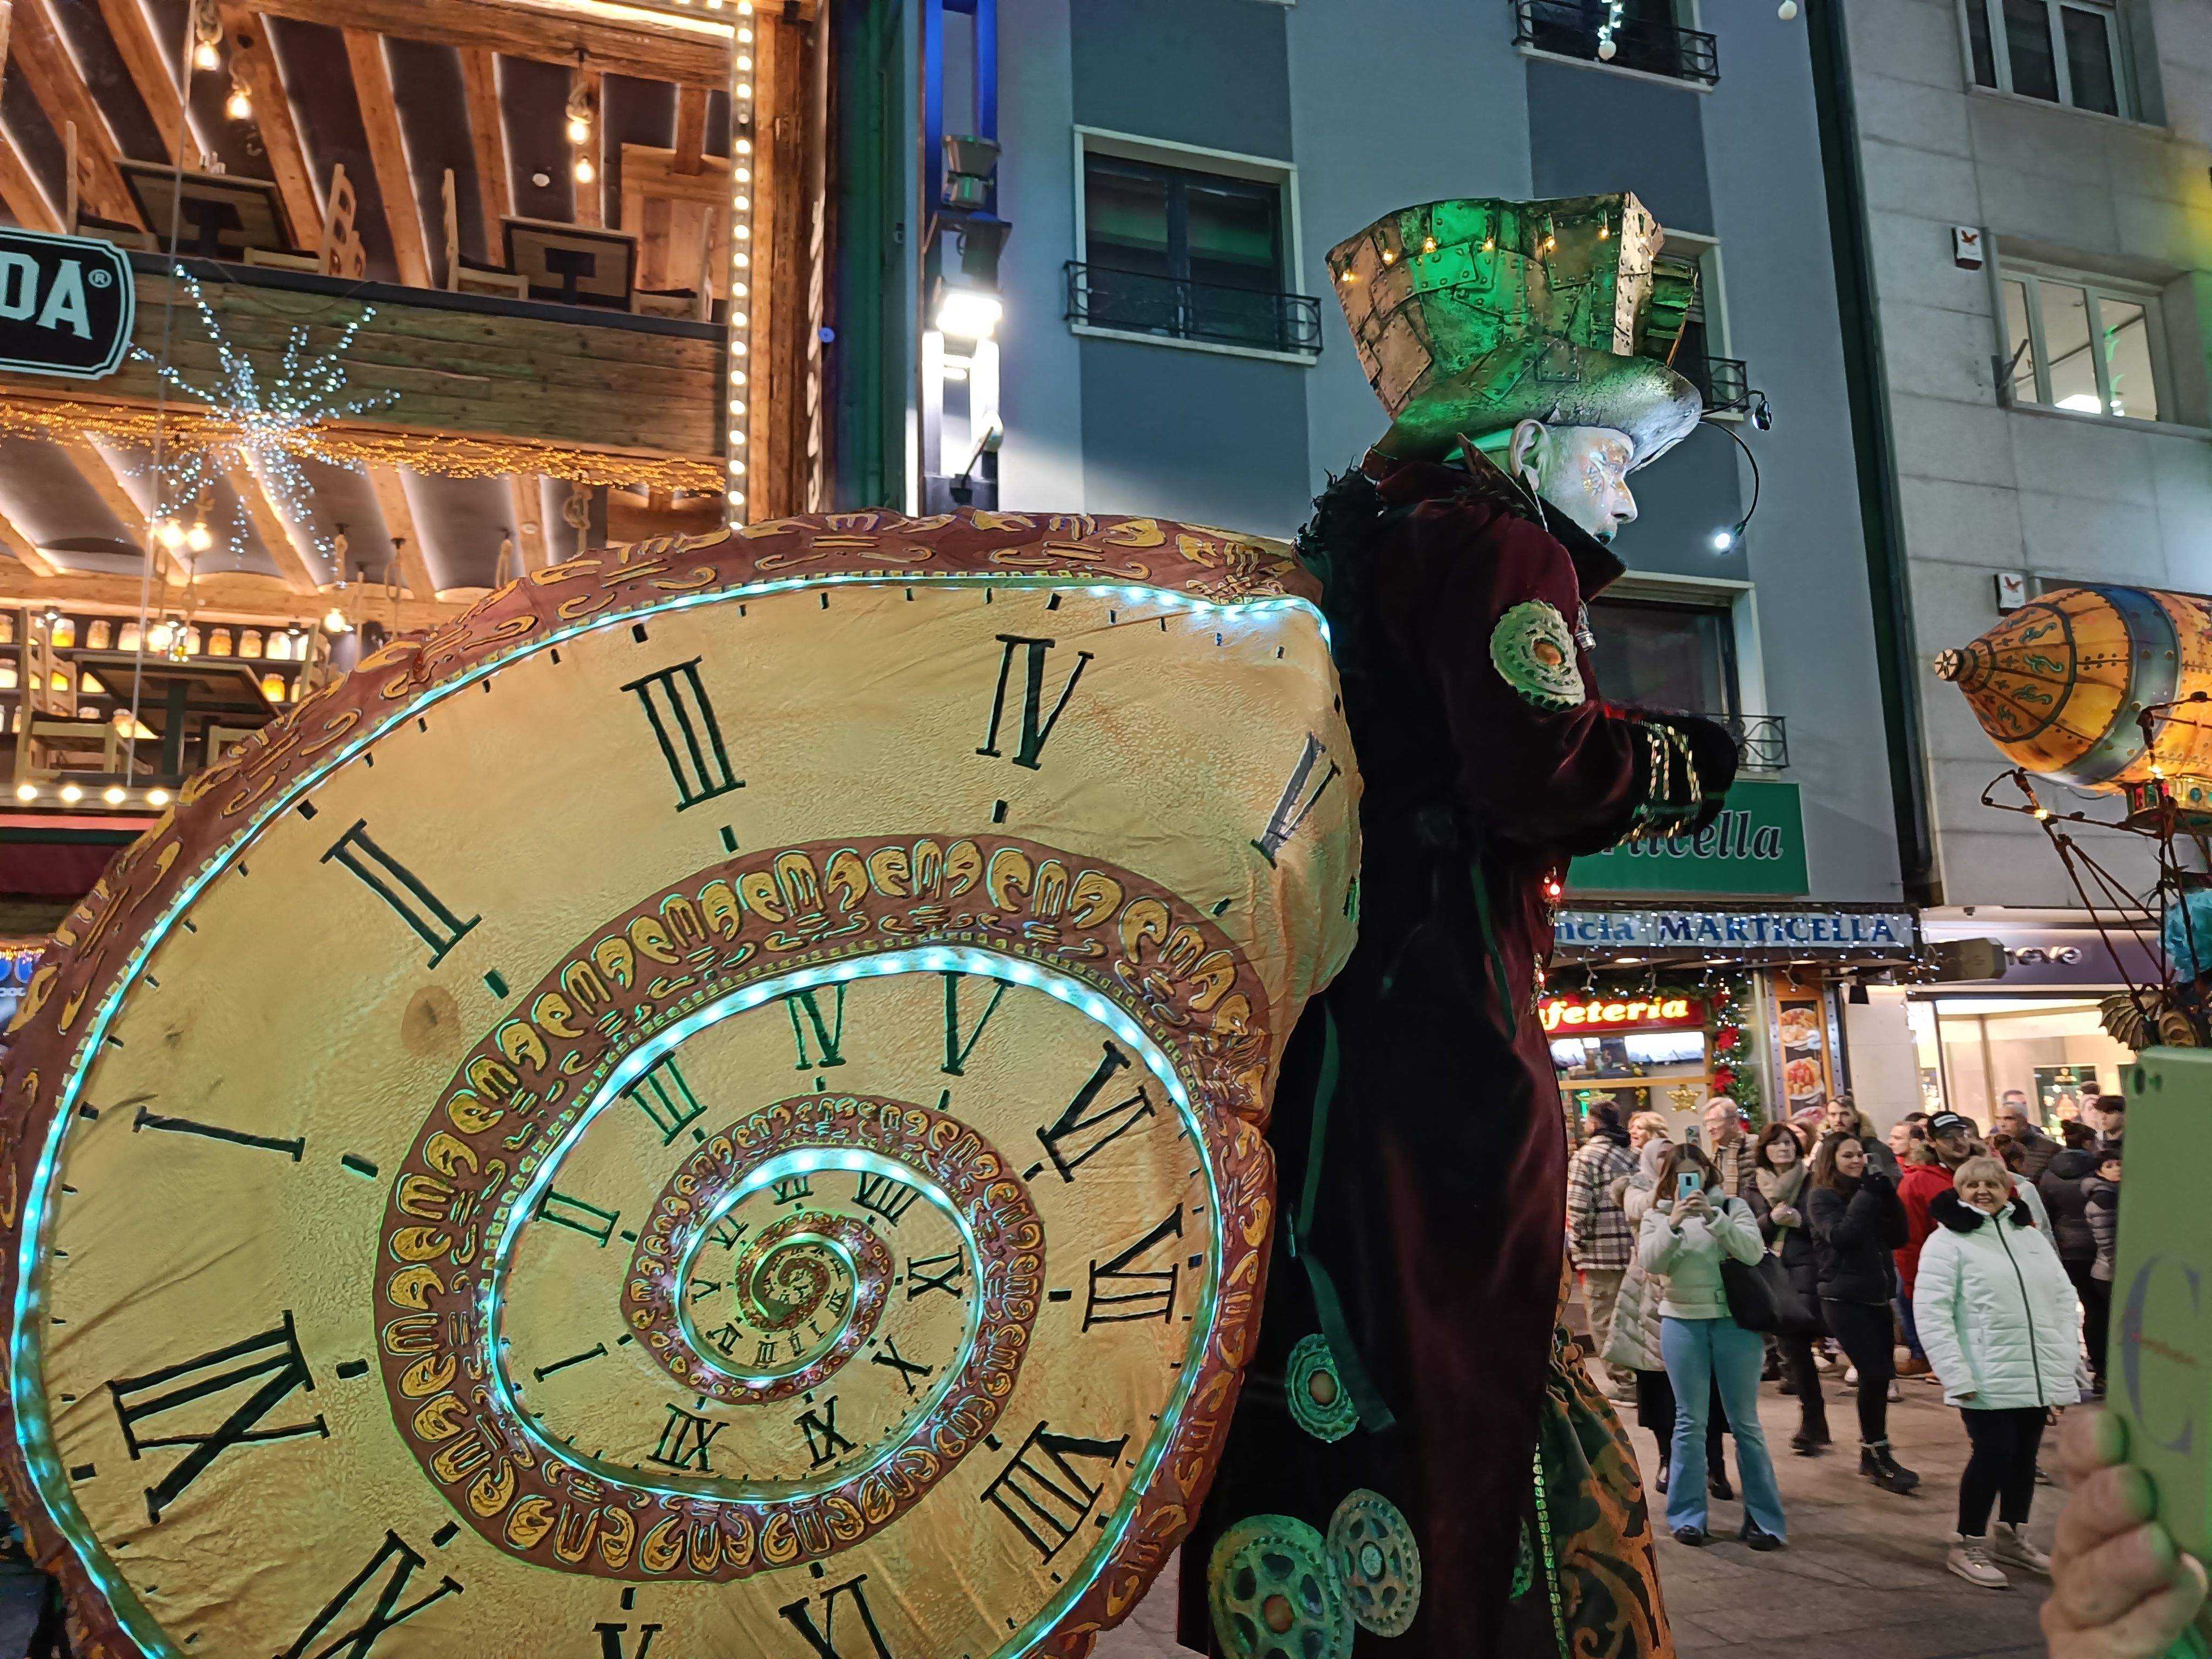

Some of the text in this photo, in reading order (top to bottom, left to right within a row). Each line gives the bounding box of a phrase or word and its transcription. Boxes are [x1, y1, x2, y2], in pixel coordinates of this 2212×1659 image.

[620, 656, 745, 812] III
[976, 633, 1094, 770] IV
[1251, 731, 1340, 869] V
[321, 818, 482, 969] II
[1555, 914, 1896, 942] ncia MARTICELLA
[783, 980, 849, 1070] IV
[940, 972, 1015, 1076] V
[622, 1050, 707, 1145] III
[1036, 1040, 1156, 1183] VI
[535, 1184, 620, 1247] II
[1082, 1204, 1185, 1333] VII
[872, 1335, 933, 1394] X
